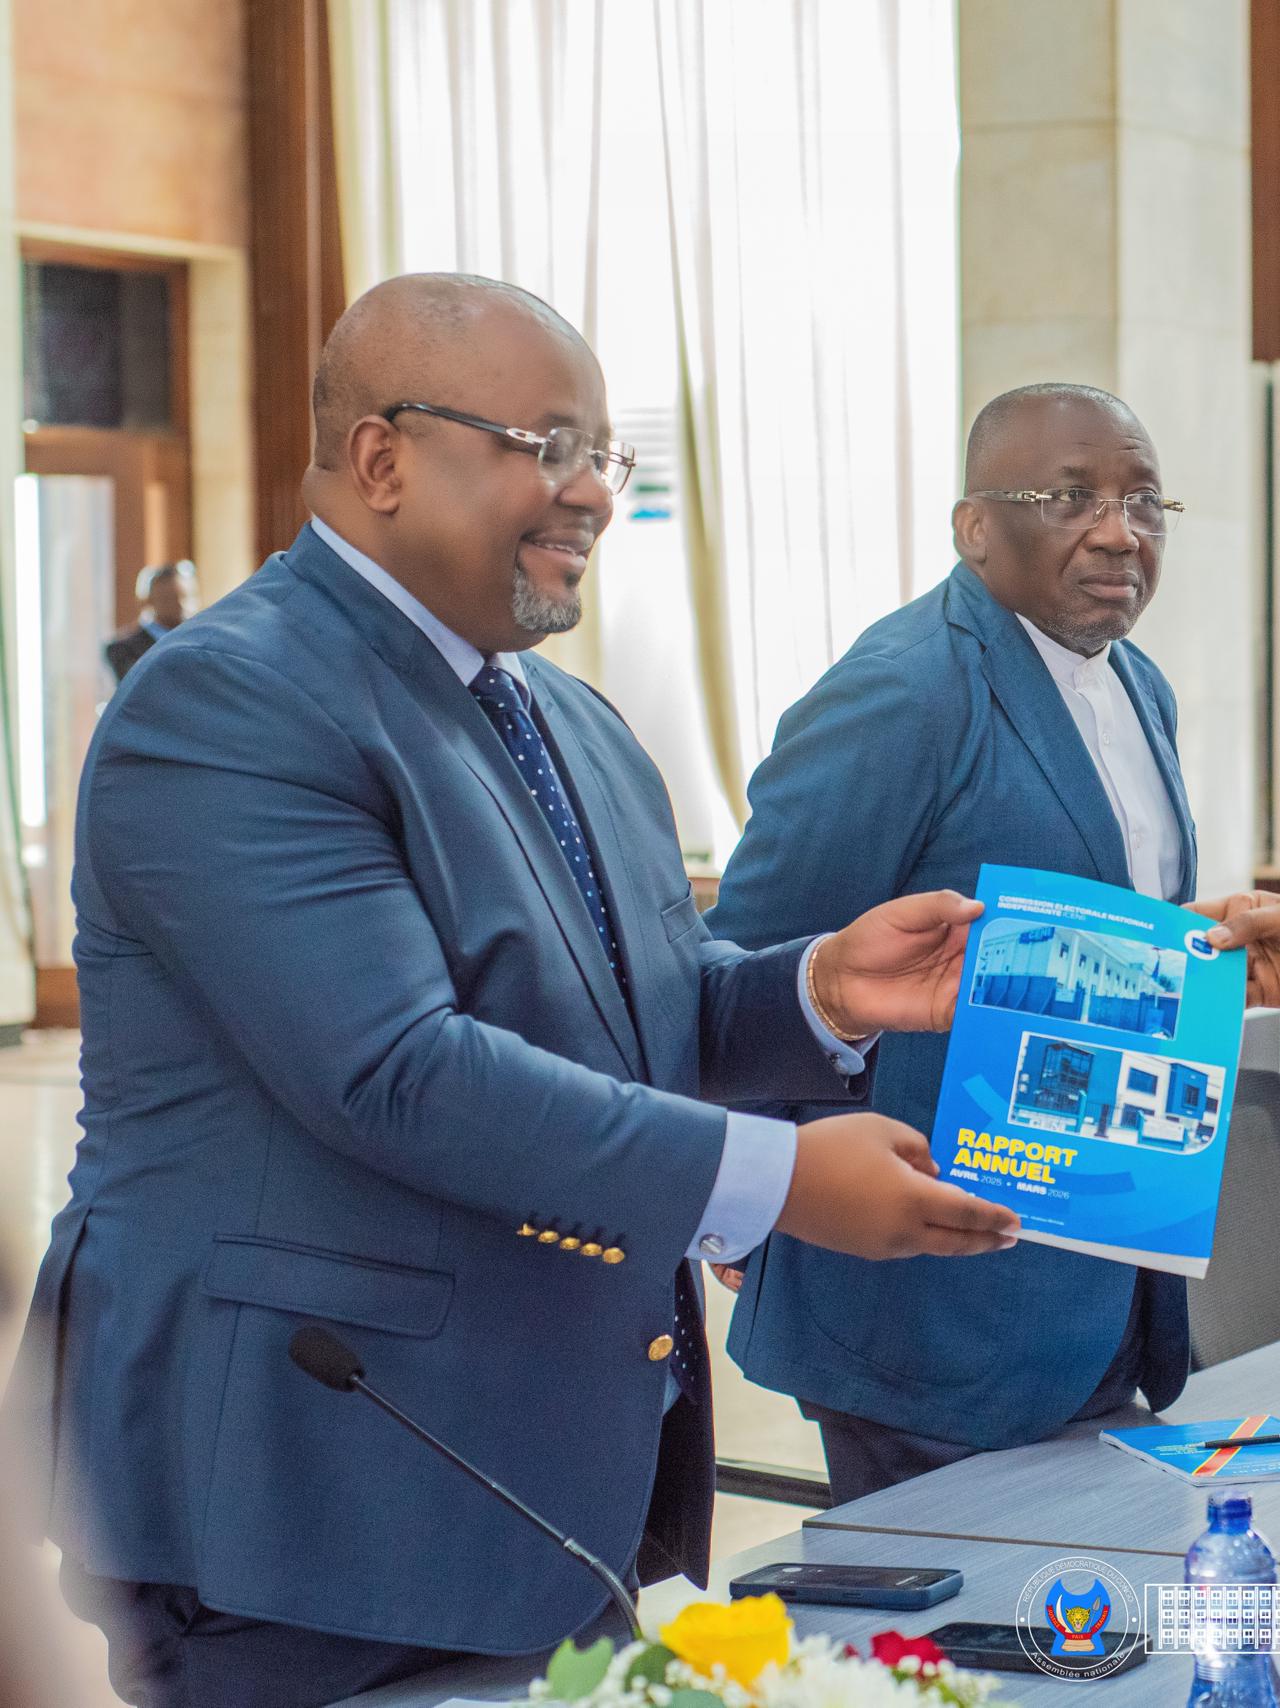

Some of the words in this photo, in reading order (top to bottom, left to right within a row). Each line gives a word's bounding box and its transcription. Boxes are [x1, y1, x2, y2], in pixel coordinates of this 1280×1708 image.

[957, 1128, 1078, 1167] RAPPORT
[949, 1168, 979, 1182] AVRIL
[980, 1175, 1002, 1187] 2025
[1016, 1181, 1047, 1195] MARS
[953, 1148, 1056, 1184] ANNUEL
